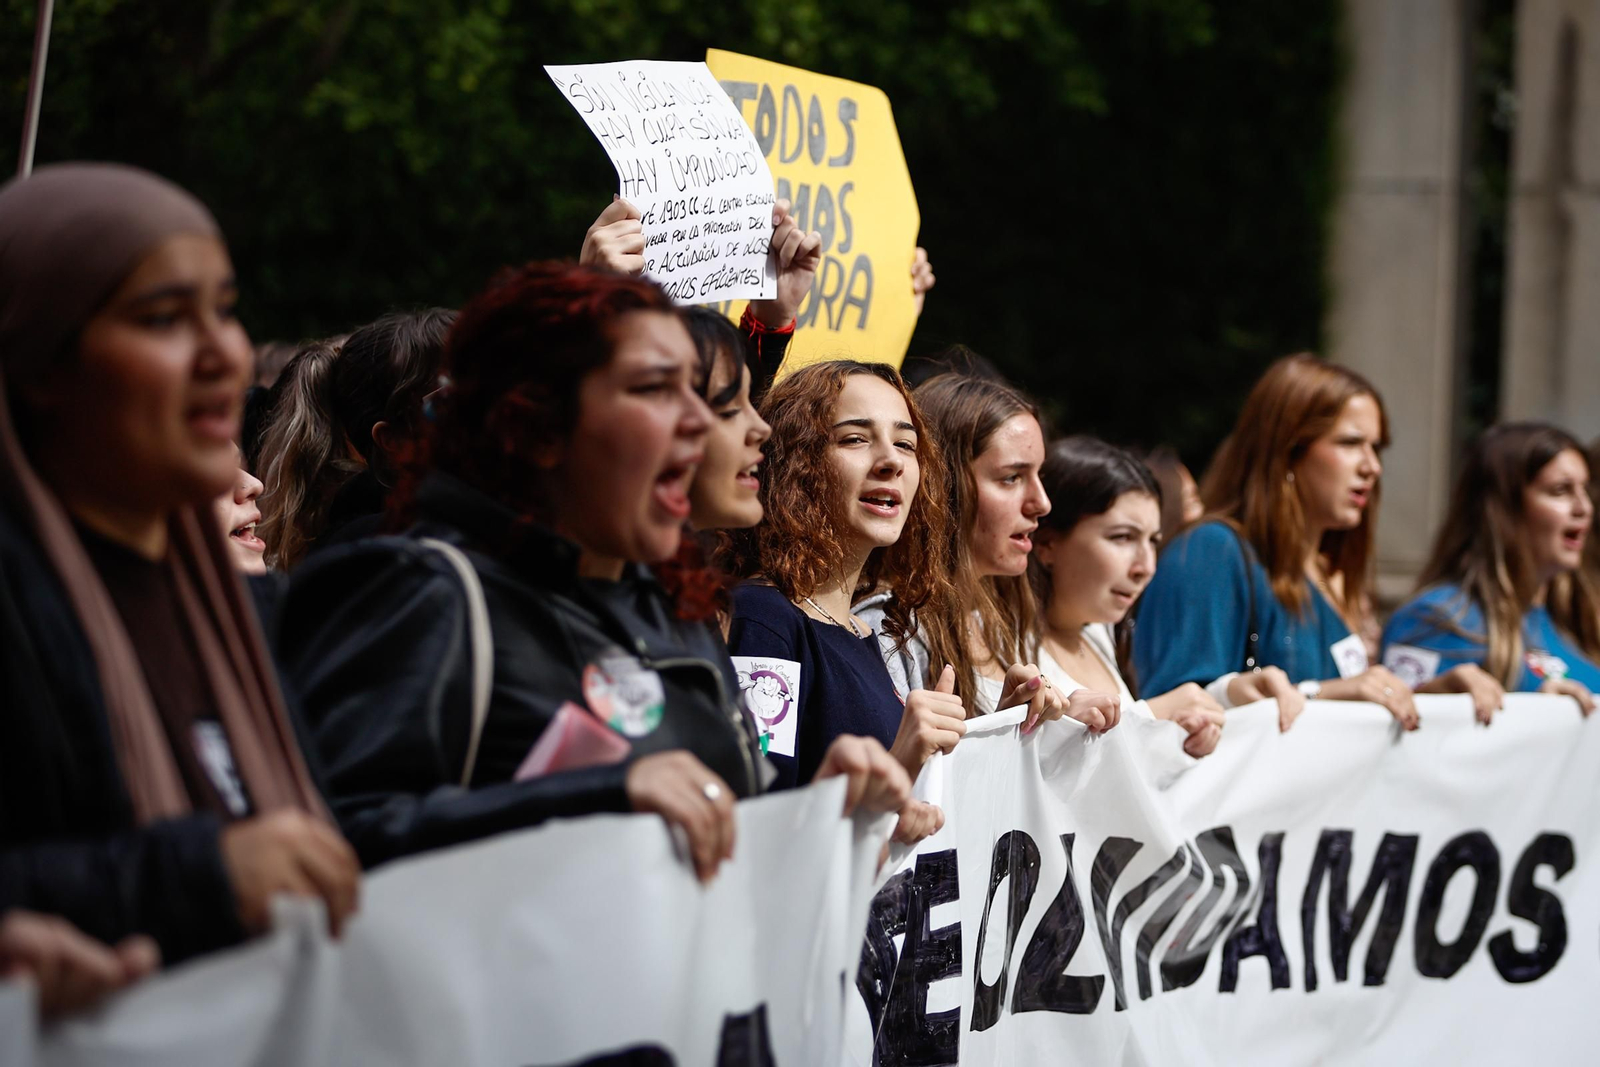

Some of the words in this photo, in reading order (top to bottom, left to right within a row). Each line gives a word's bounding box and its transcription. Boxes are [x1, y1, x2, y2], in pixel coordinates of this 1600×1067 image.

[593, 114, 636, 150] HAY
[642, 112, 694, 145] CULPA
[720, 80, 857, 167] TODOS
[616, 158, 657, 197] HAY
[659, 200, 687, 224] 1903
[719, 197, 742, 214] CENTRO
[777, 177, 853, 254] MOS
[671, 229, 687, 245] POR
[688, 224, 699, 240] LA
[725, 242, 740, 258] DE
[970, 825, 1577, 1032] OLVIDAMOS
